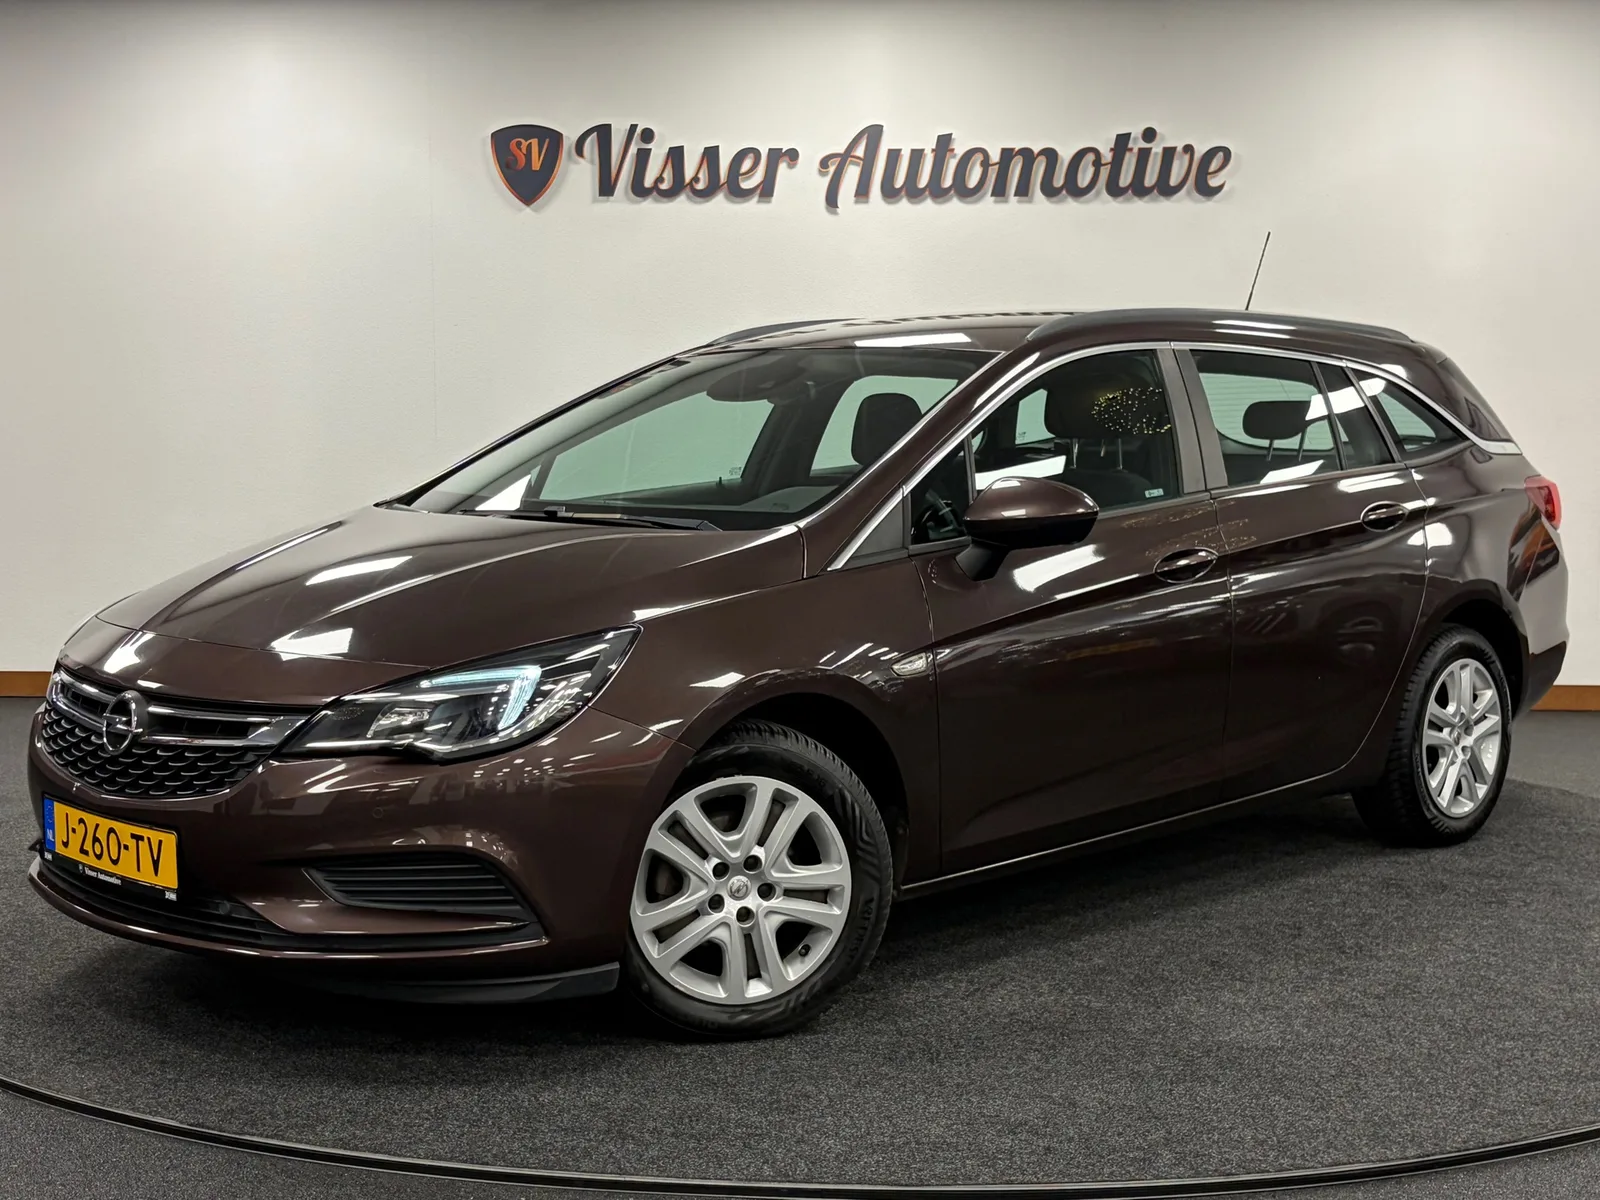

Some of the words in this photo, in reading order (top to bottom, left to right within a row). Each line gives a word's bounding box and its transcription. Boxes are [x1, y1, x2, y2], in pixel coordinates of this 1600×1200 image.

[505, 137, 550, 171] SV
[574, 123, 800, 199] Visser
[818, 123, 1233, 209] Automotive
[46, 828, 55, 842] NL
[61, 812, 163, 877] J-260-TV
